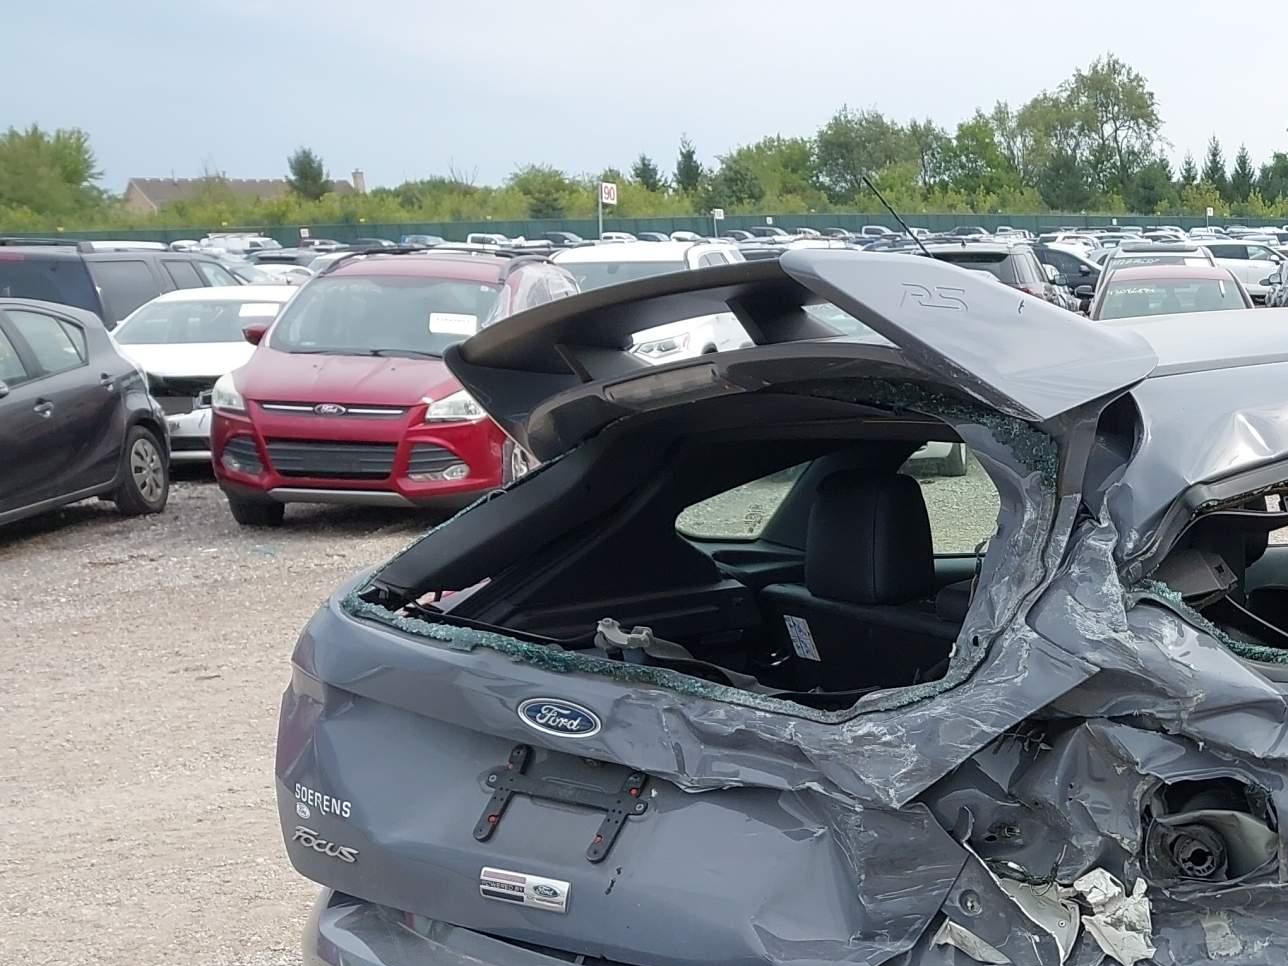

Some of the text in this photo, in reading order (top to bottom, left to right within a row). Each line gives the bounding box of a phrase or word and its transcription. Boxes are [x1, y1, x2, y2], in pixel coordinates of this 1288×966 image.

[603, 187, 615, 200] 90
[900, 282, 969, 313] RS
[536, 705, 582, 730] Ford
[295, 783, 352, 818] SOERENS
